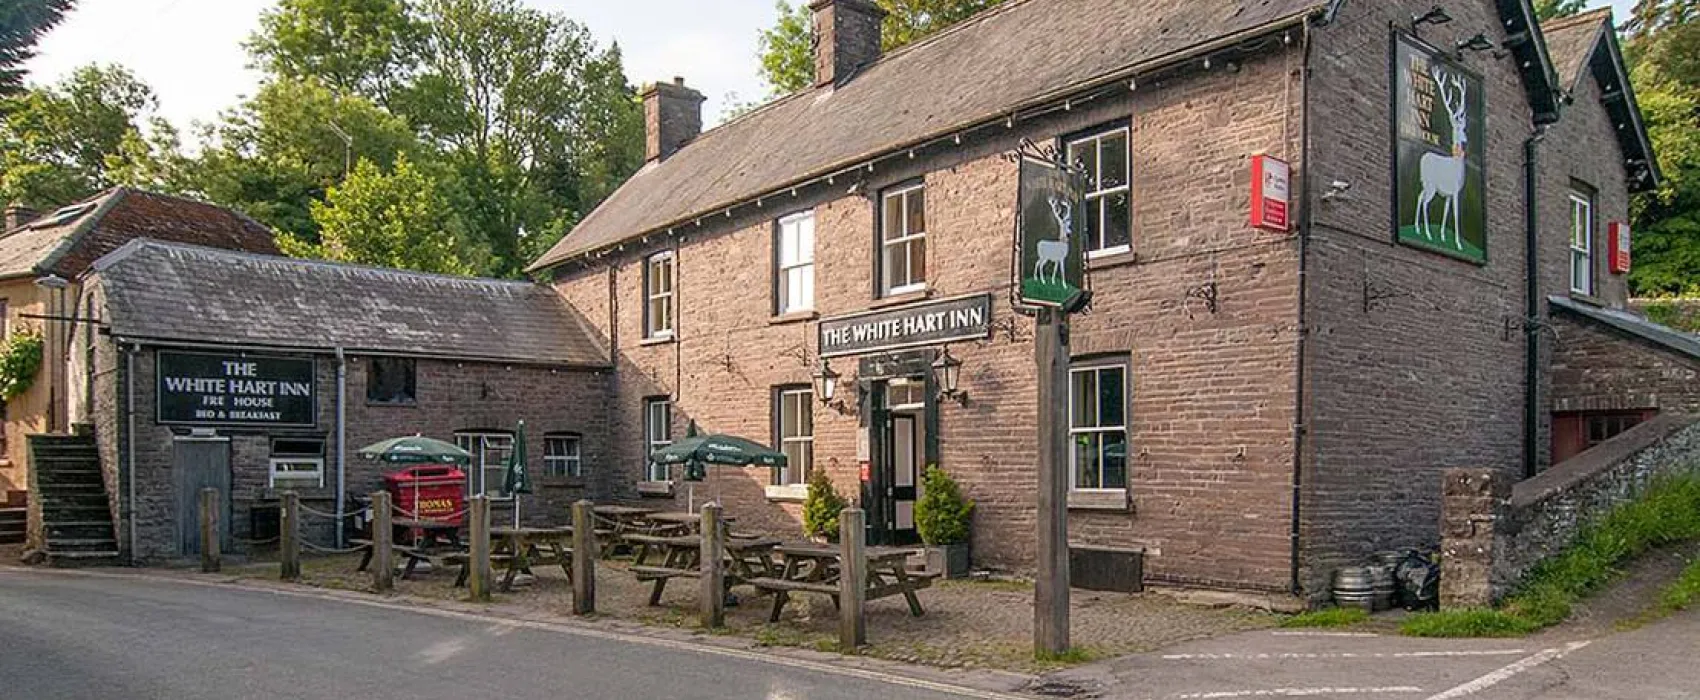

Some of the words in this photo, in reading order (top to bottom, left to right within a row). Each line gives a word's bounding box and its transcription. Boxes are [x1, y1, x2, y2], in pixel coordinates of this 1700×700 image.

[823, 325, 850, 346] THE
[852, 318, 900, 341] WHITE
[903, 311, 946, 336] HART
[950, 306, 983, 329] INN
[222, 360, 257, 376] THE
[165, 376, 226, 394] WHITE
[229, 380, 277, 396] HART
[279, 381, 311, 396] INN
[233, 397, 274, 408] HOUSE
[217, 410, 226, 419] &
[229, 411, 282, 420] BREAKFAST
